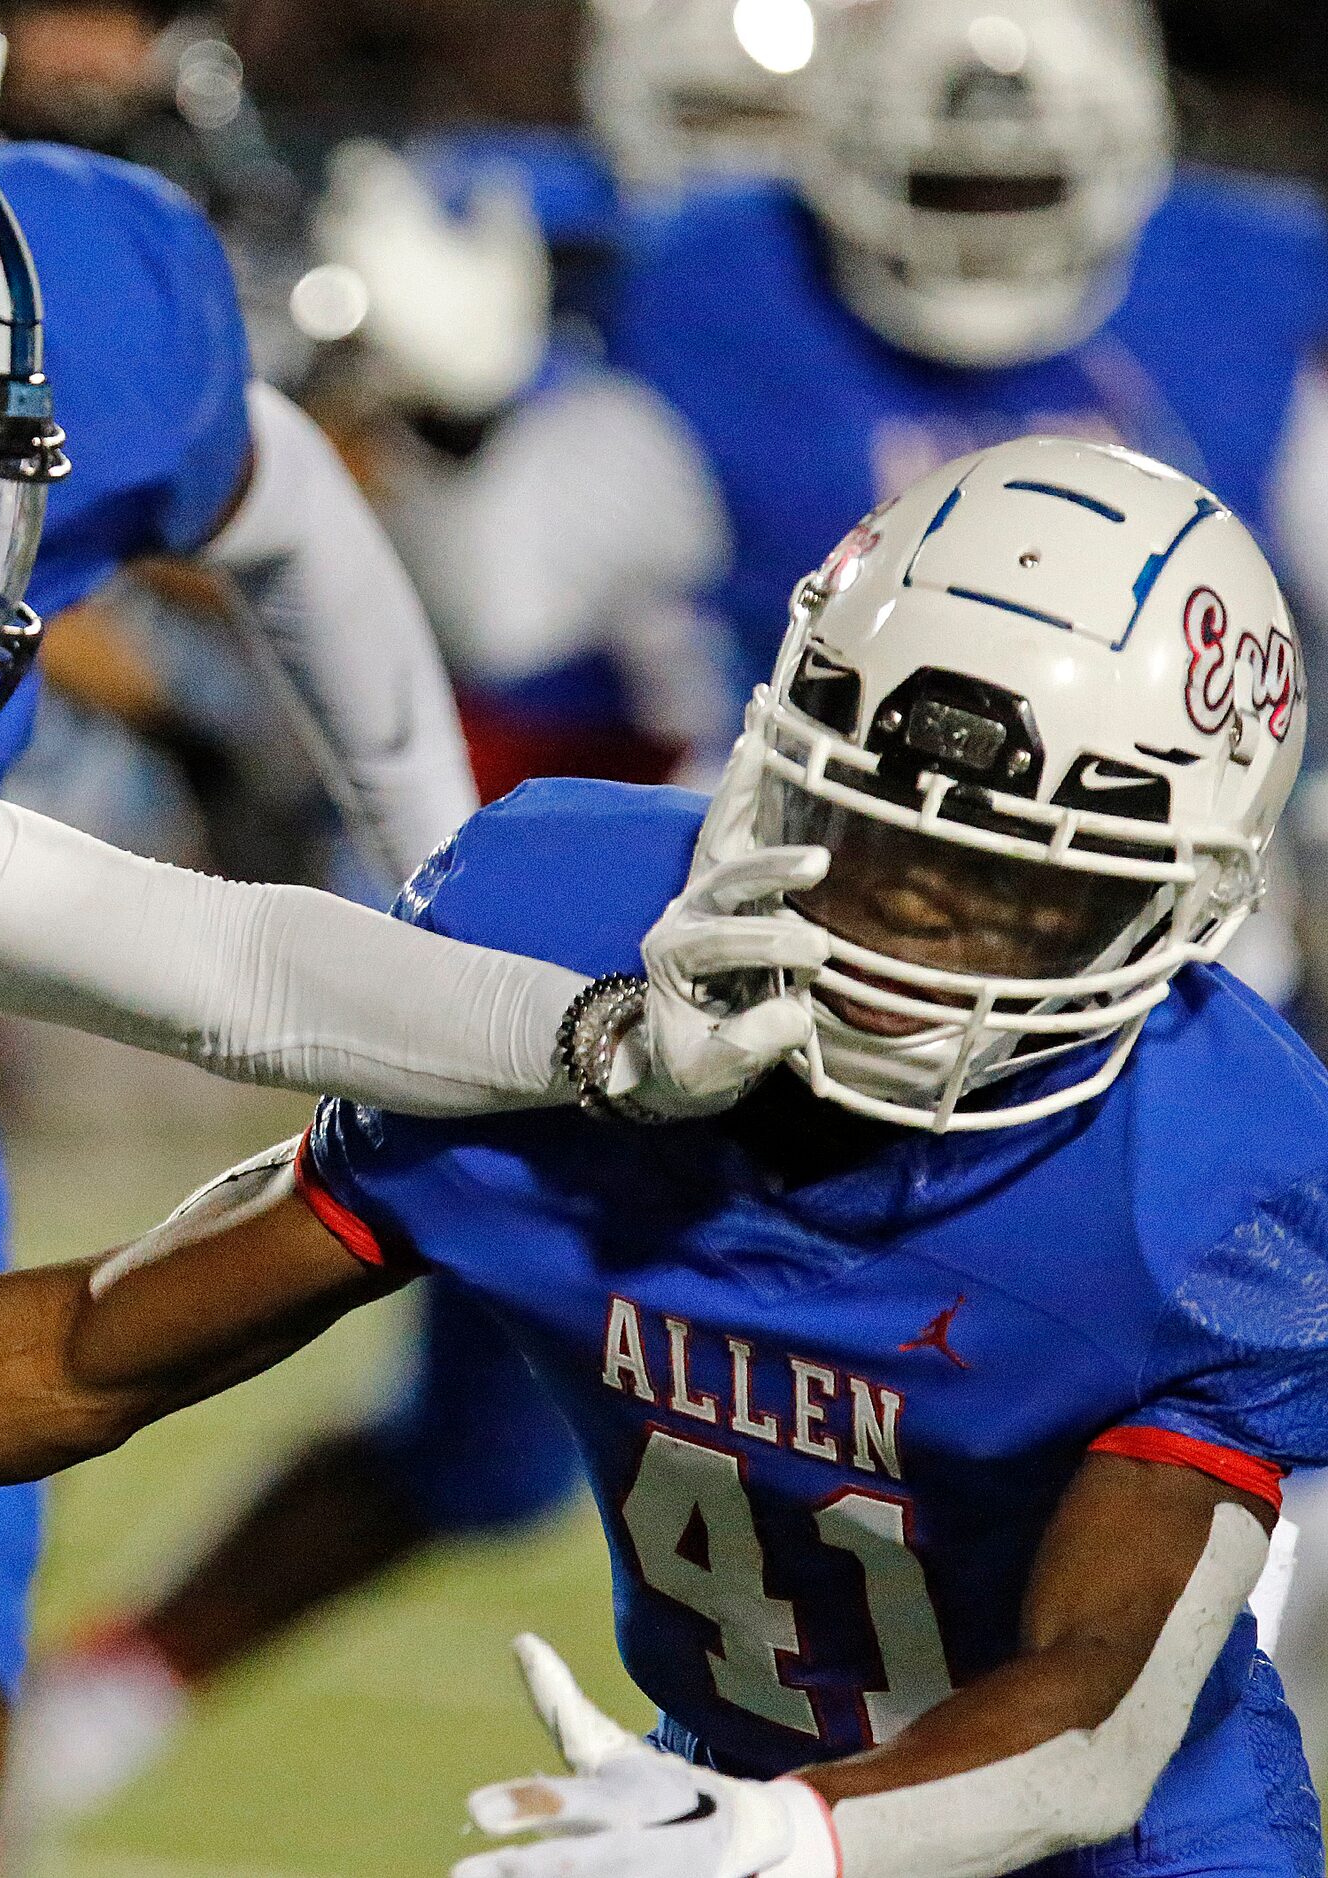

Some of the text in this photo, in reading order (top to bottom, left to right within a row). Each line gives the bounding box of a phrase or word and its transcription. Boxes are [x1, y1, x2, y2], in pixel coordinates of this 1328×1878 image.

[1184, 586, 1304, 743] Eag
[601, 1295, 906, 1481] ALLEN
[621, 1424, 954, 1746] 41
